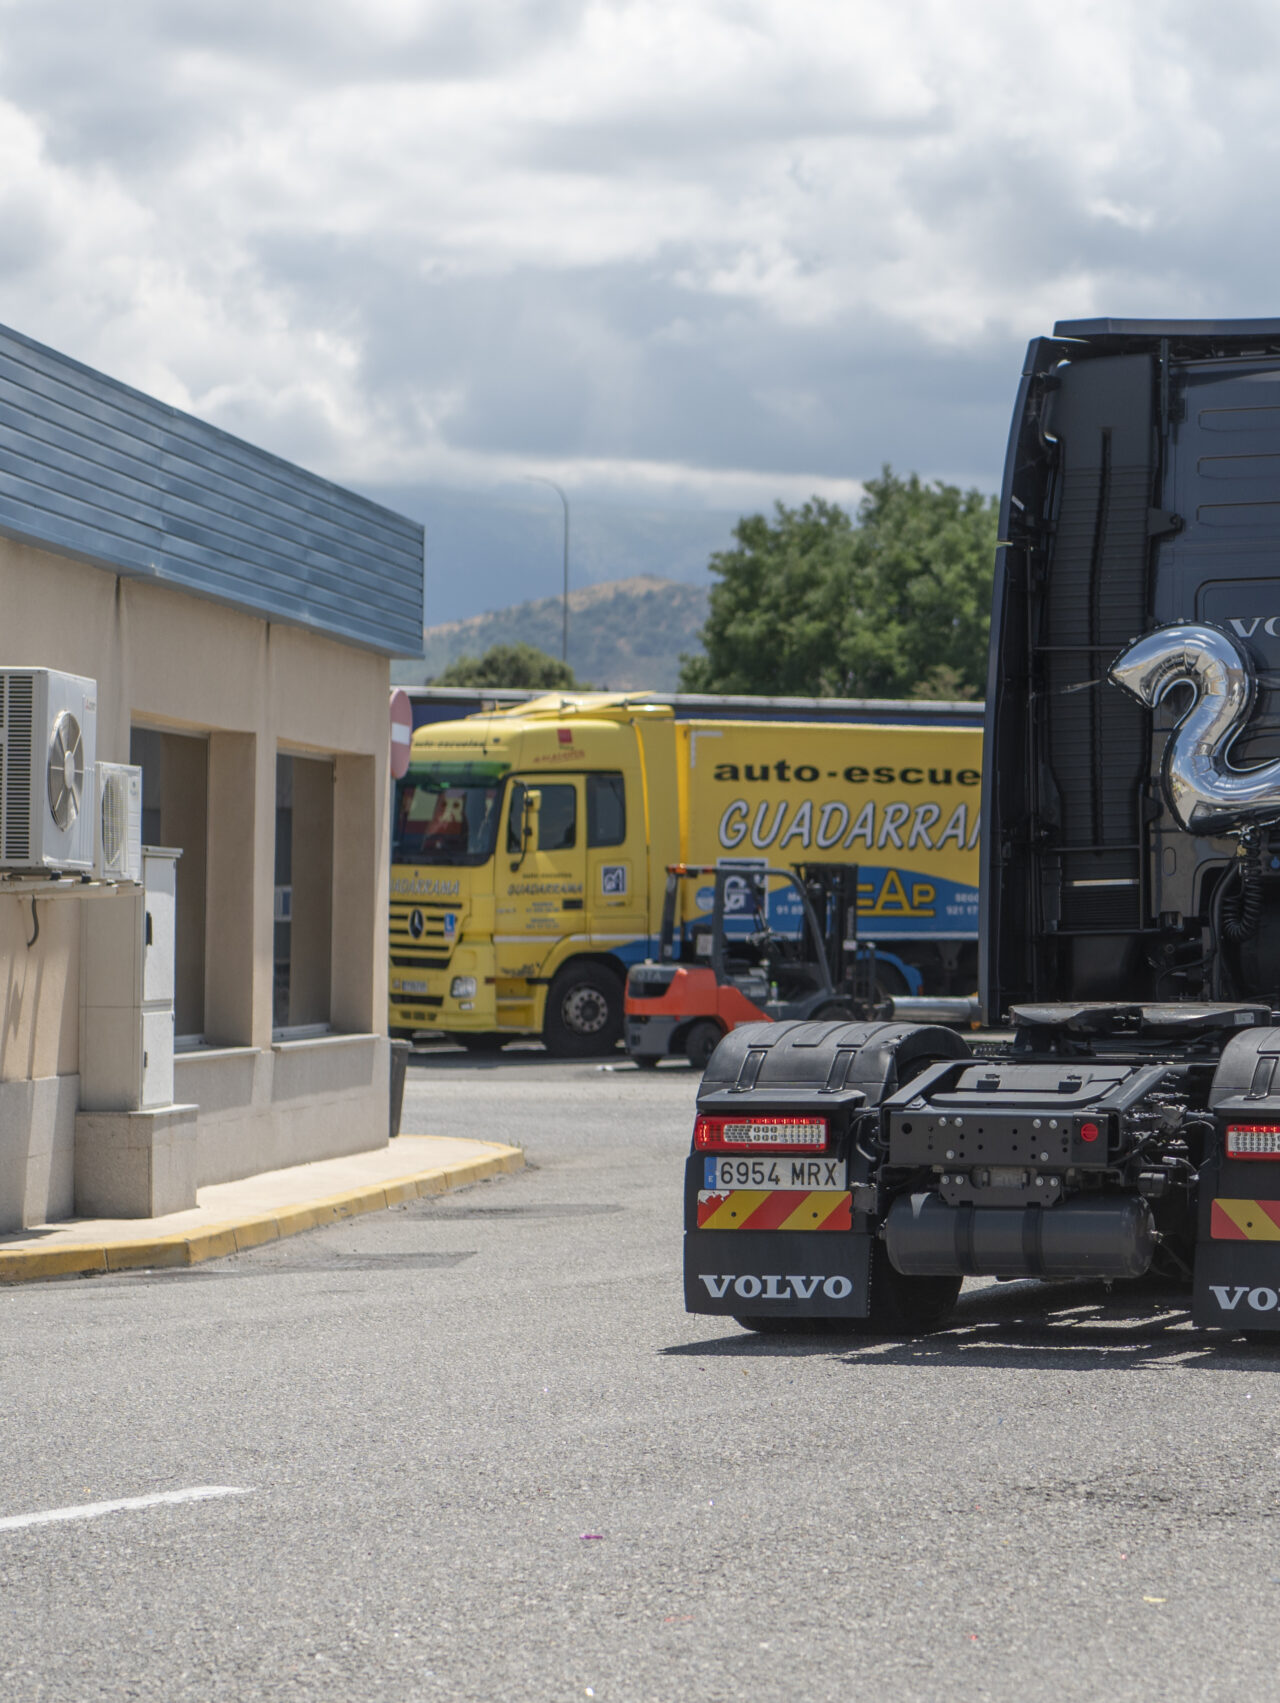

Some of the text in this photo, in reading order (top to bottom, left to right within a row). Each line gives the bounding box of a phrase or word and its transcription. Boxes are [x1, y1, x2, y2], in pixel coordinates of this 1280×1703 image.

[718, 799, 981, 850] GUADARRA
[720, 1162, 837, 1186] 6954 MRX
[698, 1274, 853, 1299] VOLVO
